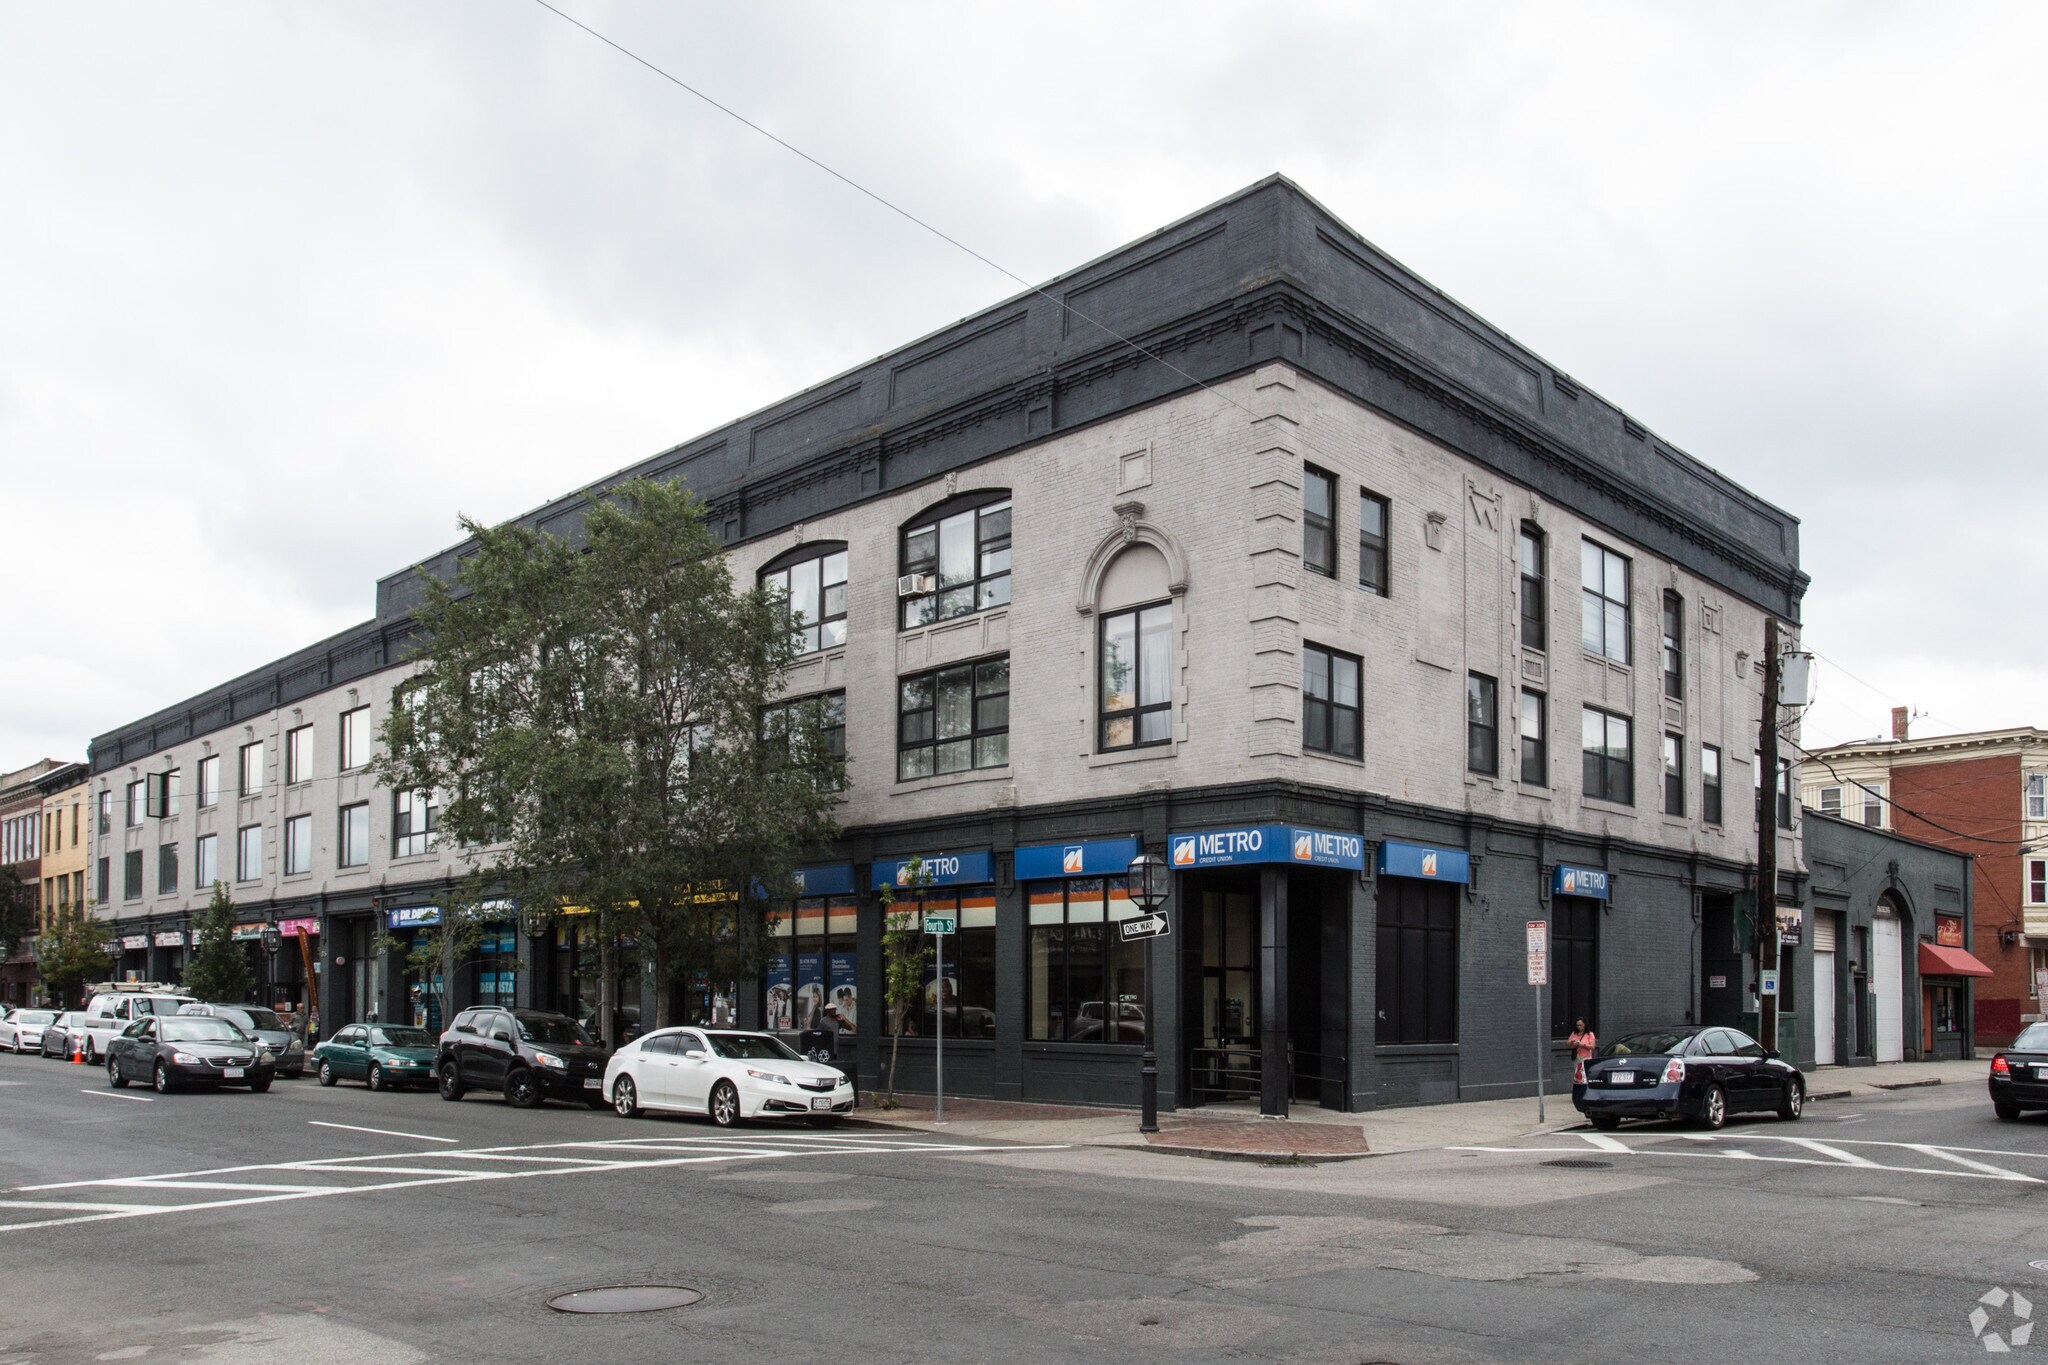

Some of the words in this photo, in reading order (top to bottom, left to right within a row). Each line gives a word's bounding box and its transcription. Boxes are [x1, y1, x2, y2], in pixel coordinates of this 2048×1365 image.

[1200, 830, 1262, 855] METRO
[1314, 833, 1359, 858] METRO
[1576, 870, 1605, 889] METRO
[925, 919, 944, 933] Fourth
[946, 920, 953, 932] St
[1125, 924, 1138, 933] ONE
[1139, 921, 1153, 931] WAY
